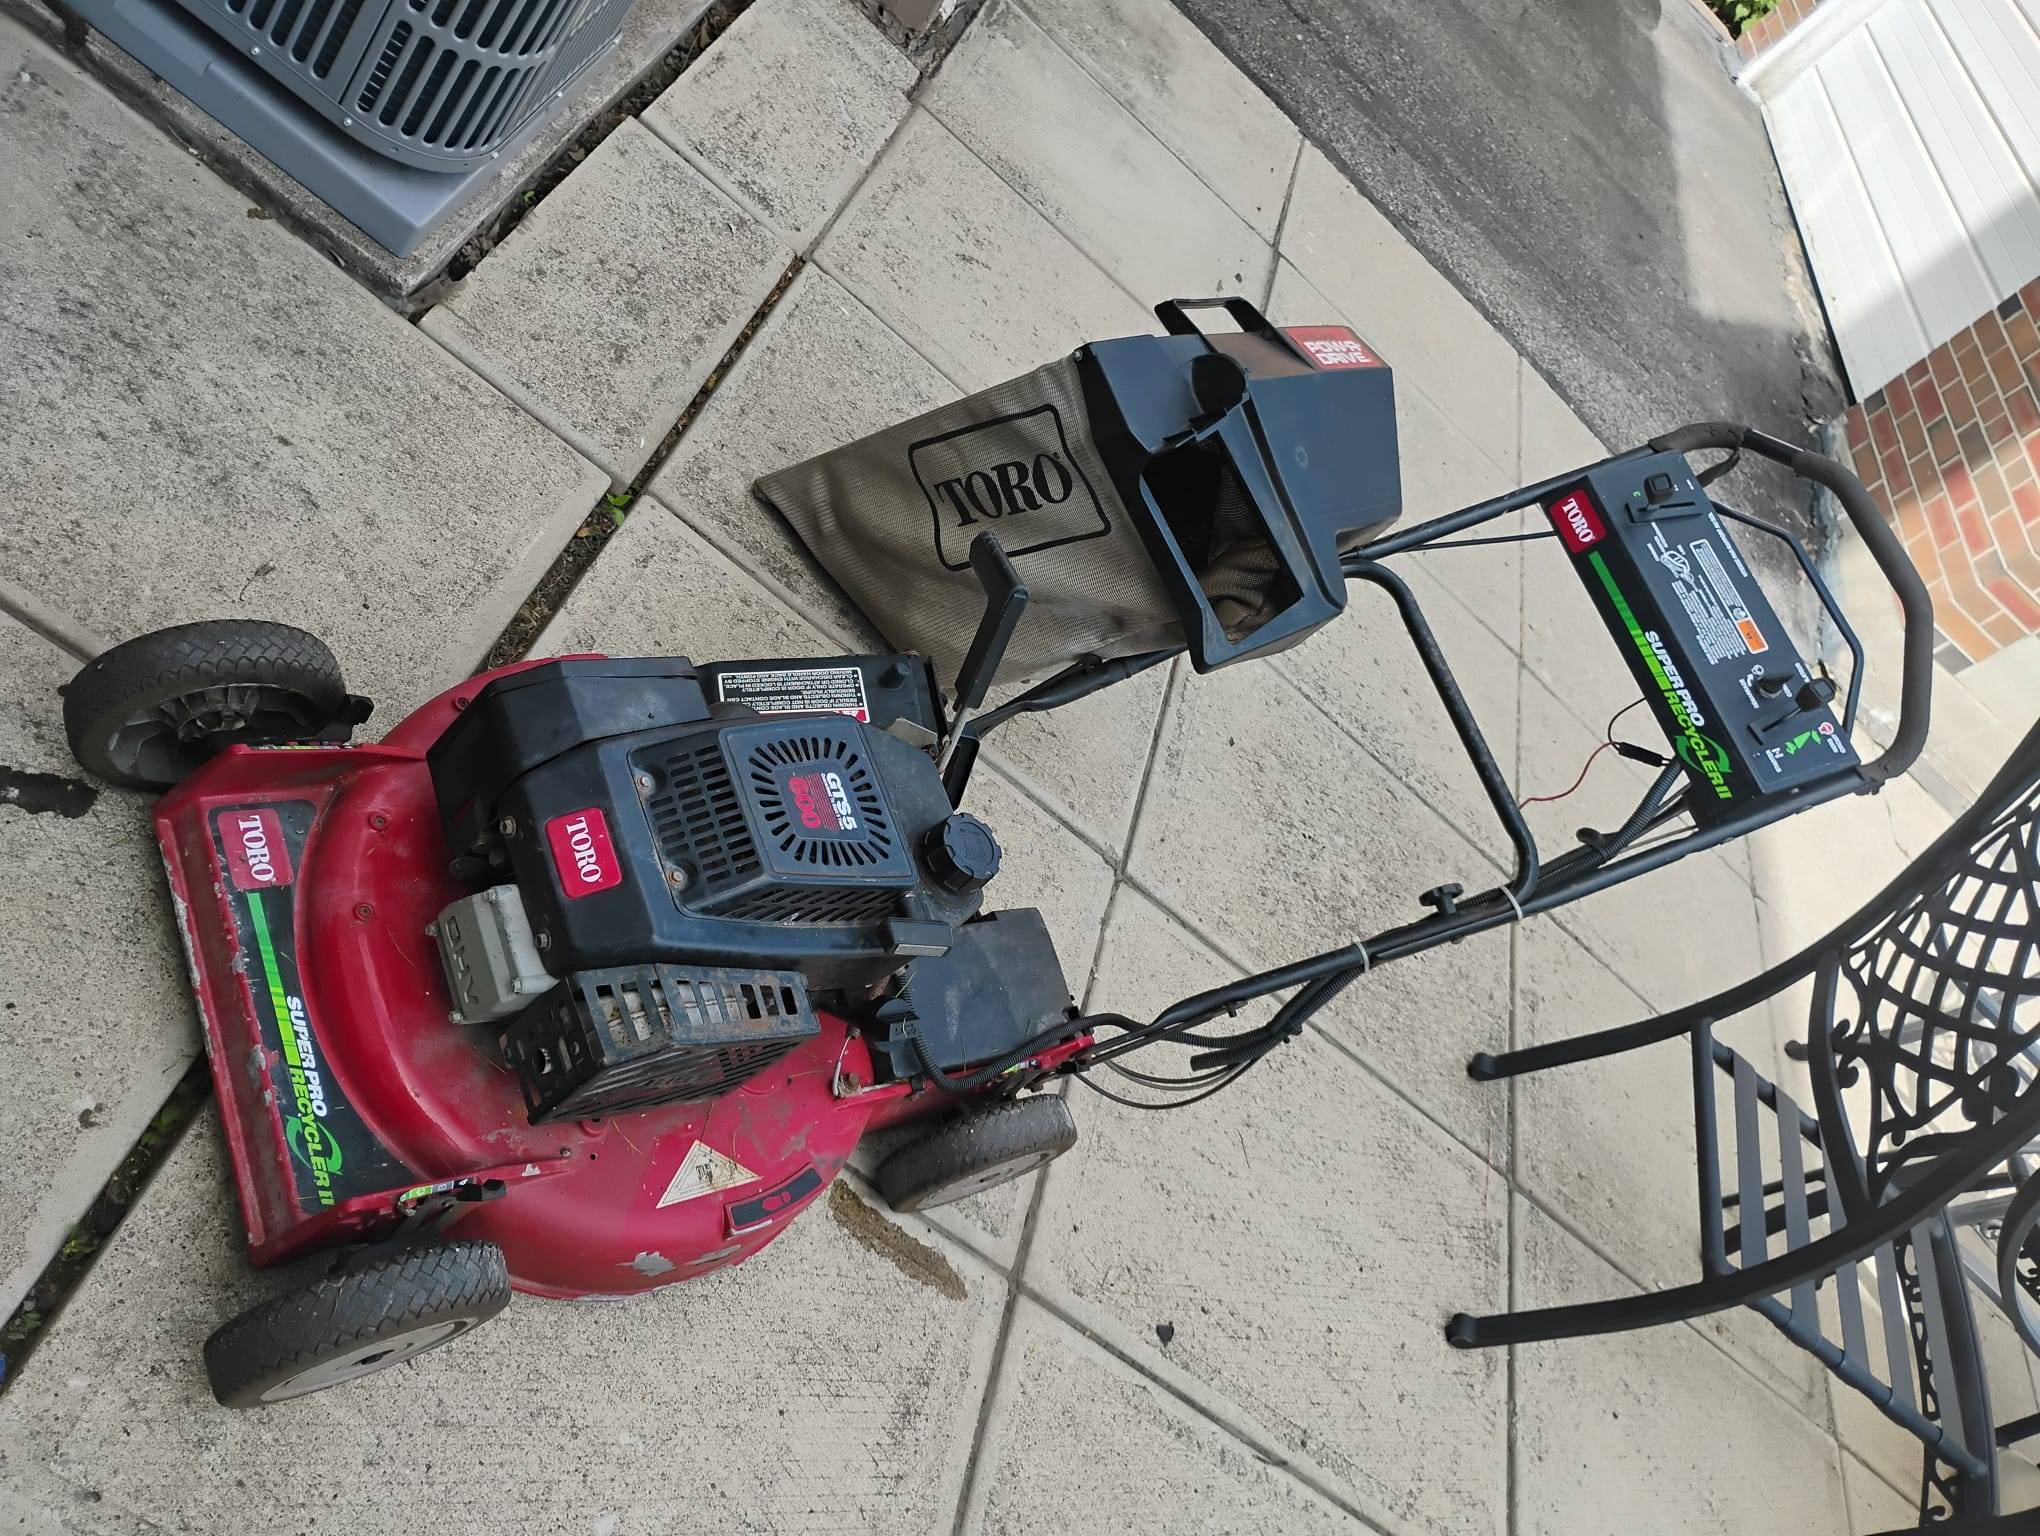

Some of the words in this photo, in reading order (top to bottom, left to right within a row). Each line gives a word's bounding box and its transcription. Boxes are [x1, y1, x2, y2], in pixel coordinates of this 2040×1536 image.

[1315, 352, 1372, 365] DRIVE
[933, 453, 1073, 527] TORO
[1561, 497, 1593, 543] TORO
[1645, 630, 1685, 689] SUPER
[1676, 689, 1705, 727] PRO
[1663, 691, 1724, 785] RECYCLER
[238, 815, 274, 881] TORO
[566, 816, 602, 882] TORO
[286, 995, 316, 1069] SUPER
[304, 1069, 328, 1117] PRO
[288, 1067, 330, 1188] RECYCLER
